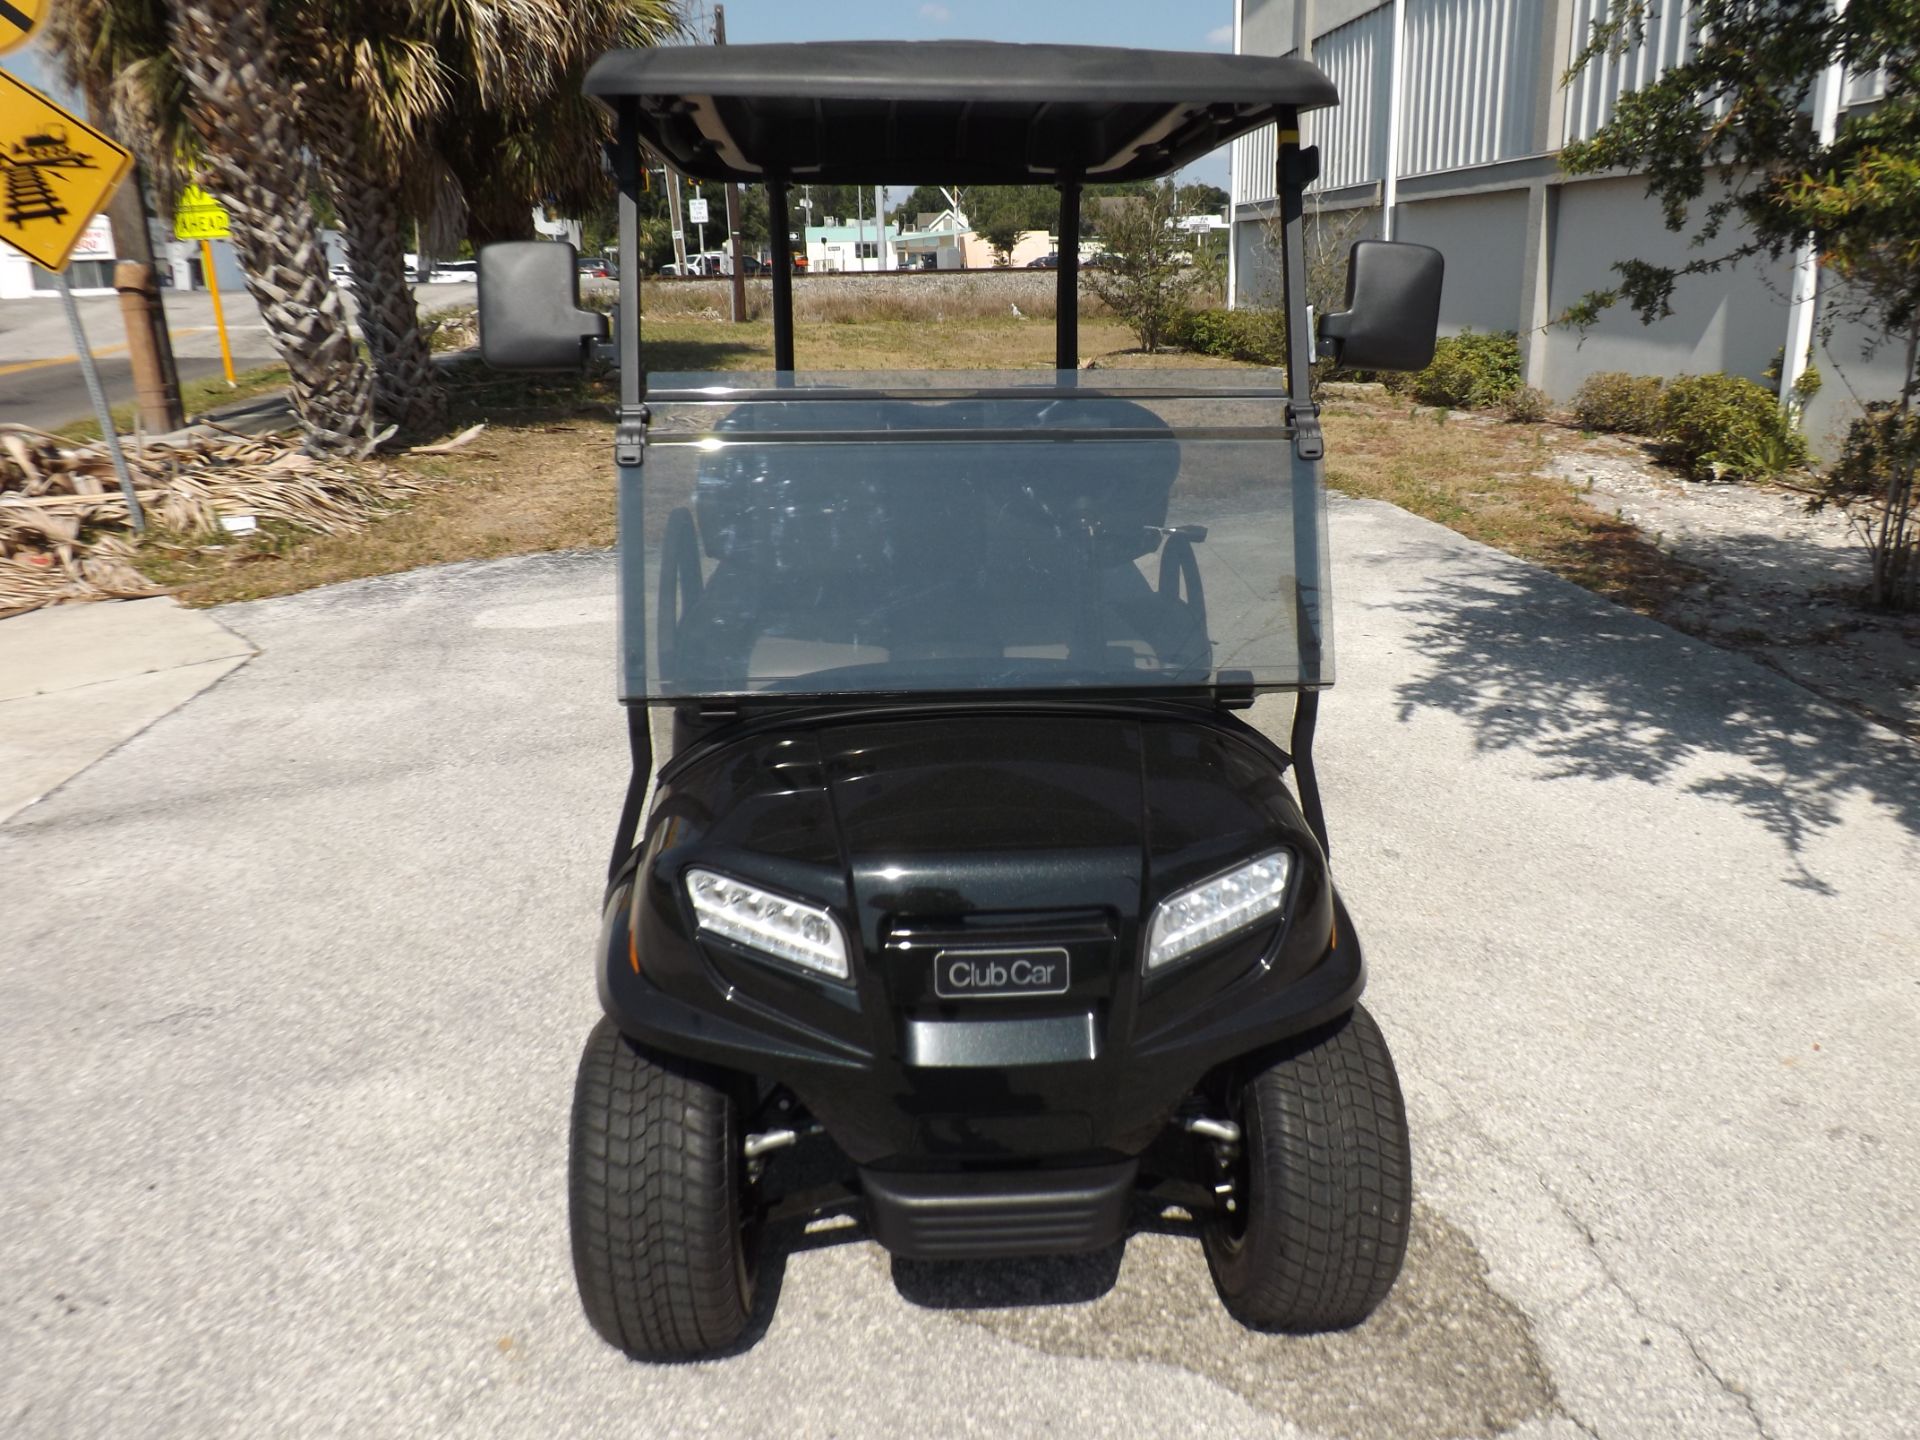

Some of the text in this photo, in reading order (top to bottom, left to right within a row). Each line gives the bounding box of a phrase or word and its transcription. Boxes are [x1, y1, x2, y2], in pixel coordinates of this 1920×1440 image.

[180, 215, 229, 233] AHEAD
[949, 959, 1055, 987] Club Car
